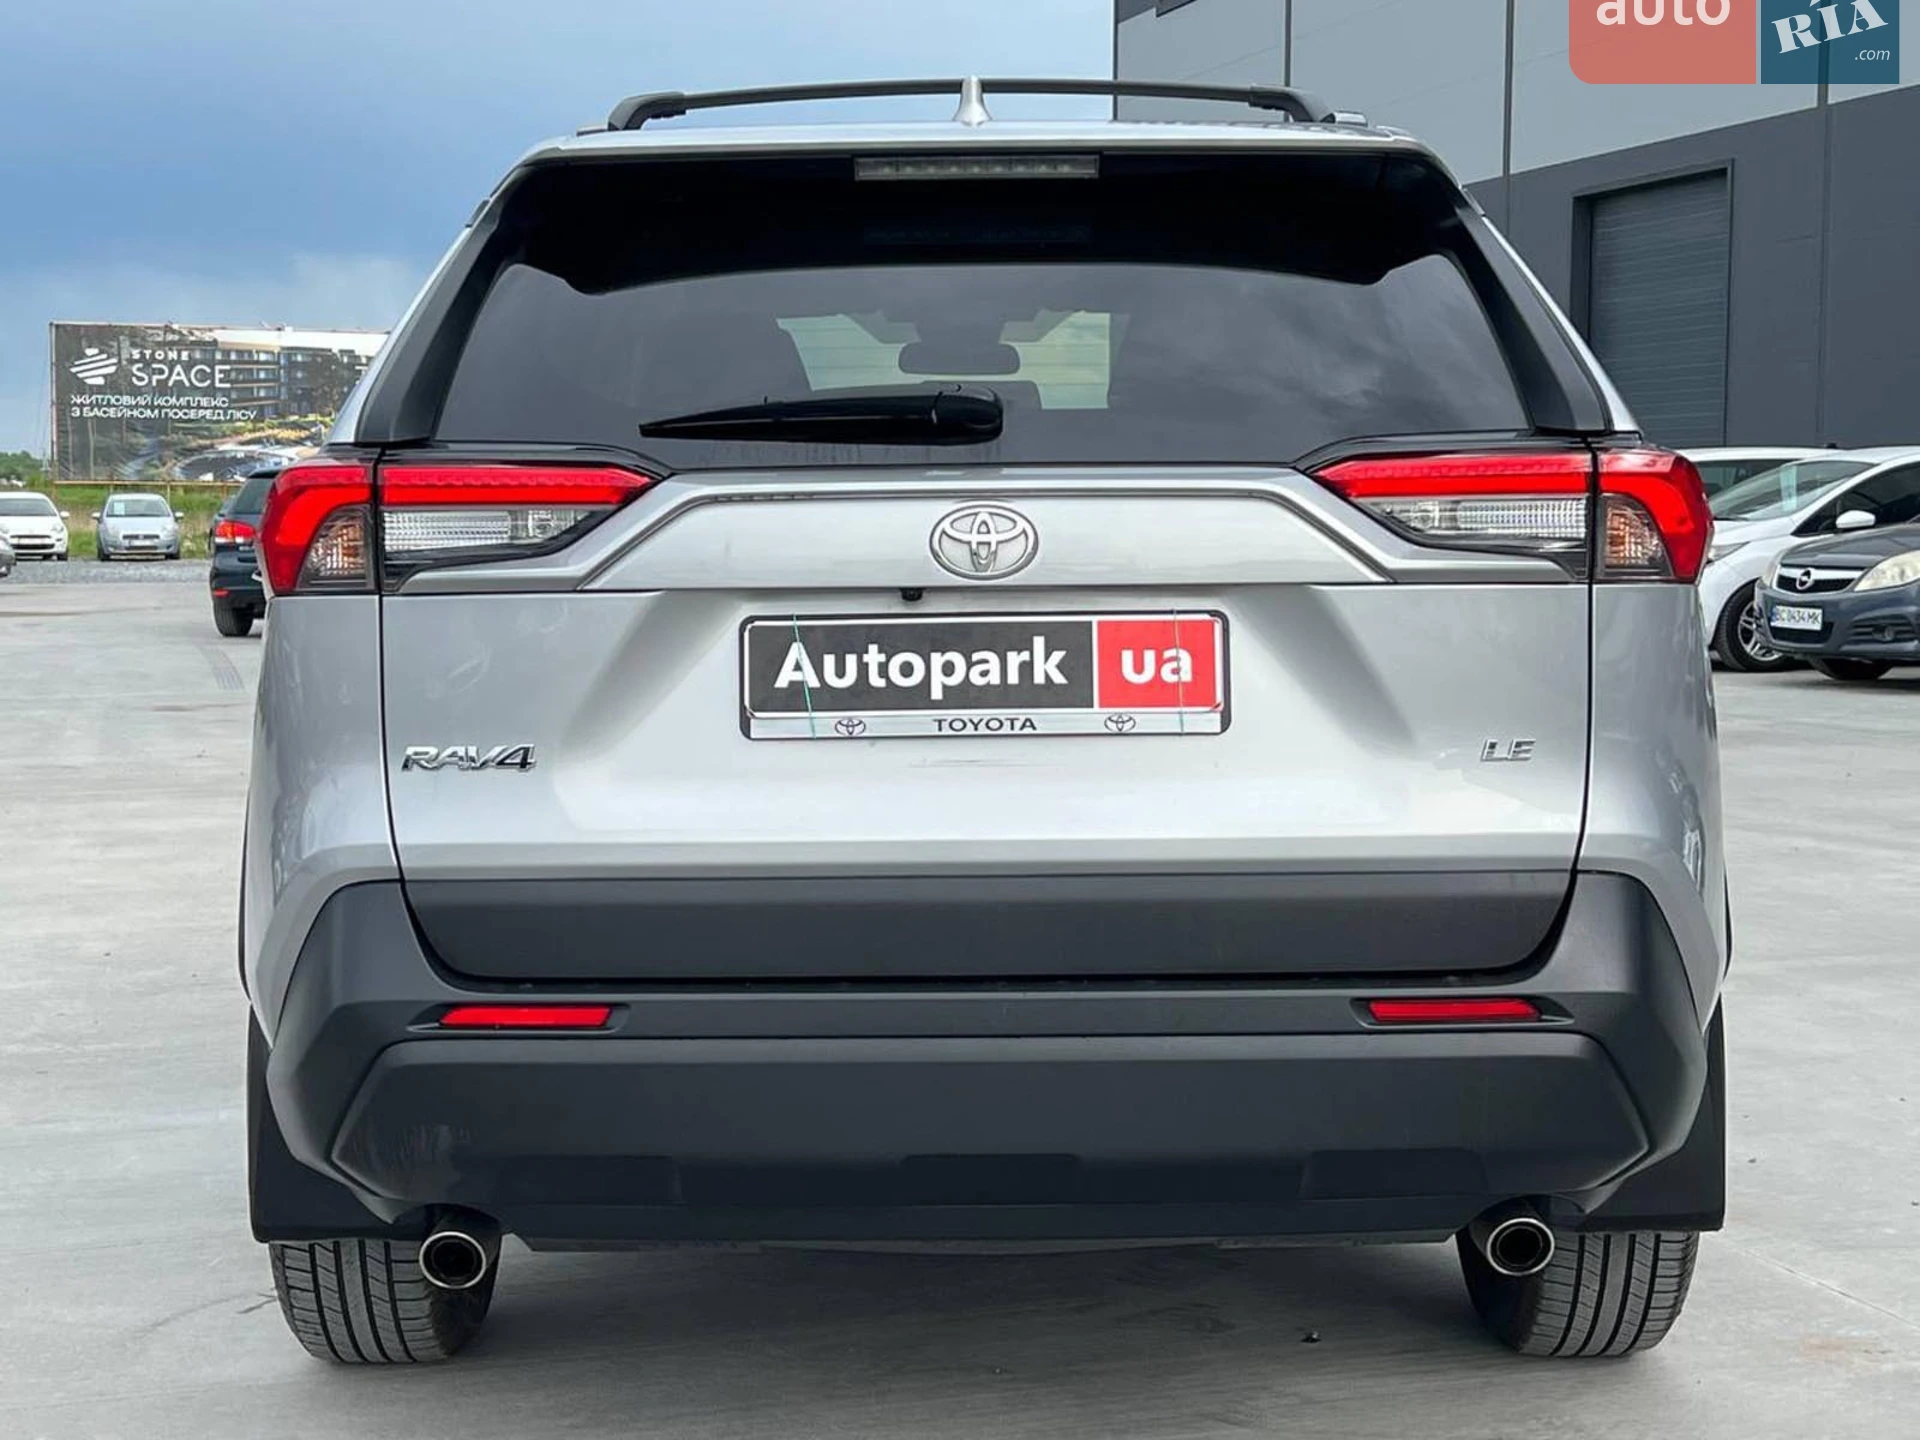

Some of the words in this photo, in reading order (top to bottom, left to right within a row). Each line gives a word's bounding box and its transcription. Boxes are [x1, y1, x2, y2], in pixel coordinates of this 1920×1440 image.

[131, 350, 190, 361] STONE
[131, 363, 231, 388] SPACE
[71, 394, 150, 407] ЖИТЛОВИЙ
[154, 396, 229, 408] КОМПЛЕКС
[83, 407, 159, 419] БАСЕЙНОМ
[161, 409, 224, 421] ПОСЕРЕД
[773, 635, 1068, 700] Autopark
[1120, 648, 1193, 685] ua
[932, 716, 1037, 733] TOYOTA
[401, 743, 536, 772] RAV4
[1480, 738, 1536, 762] LE
